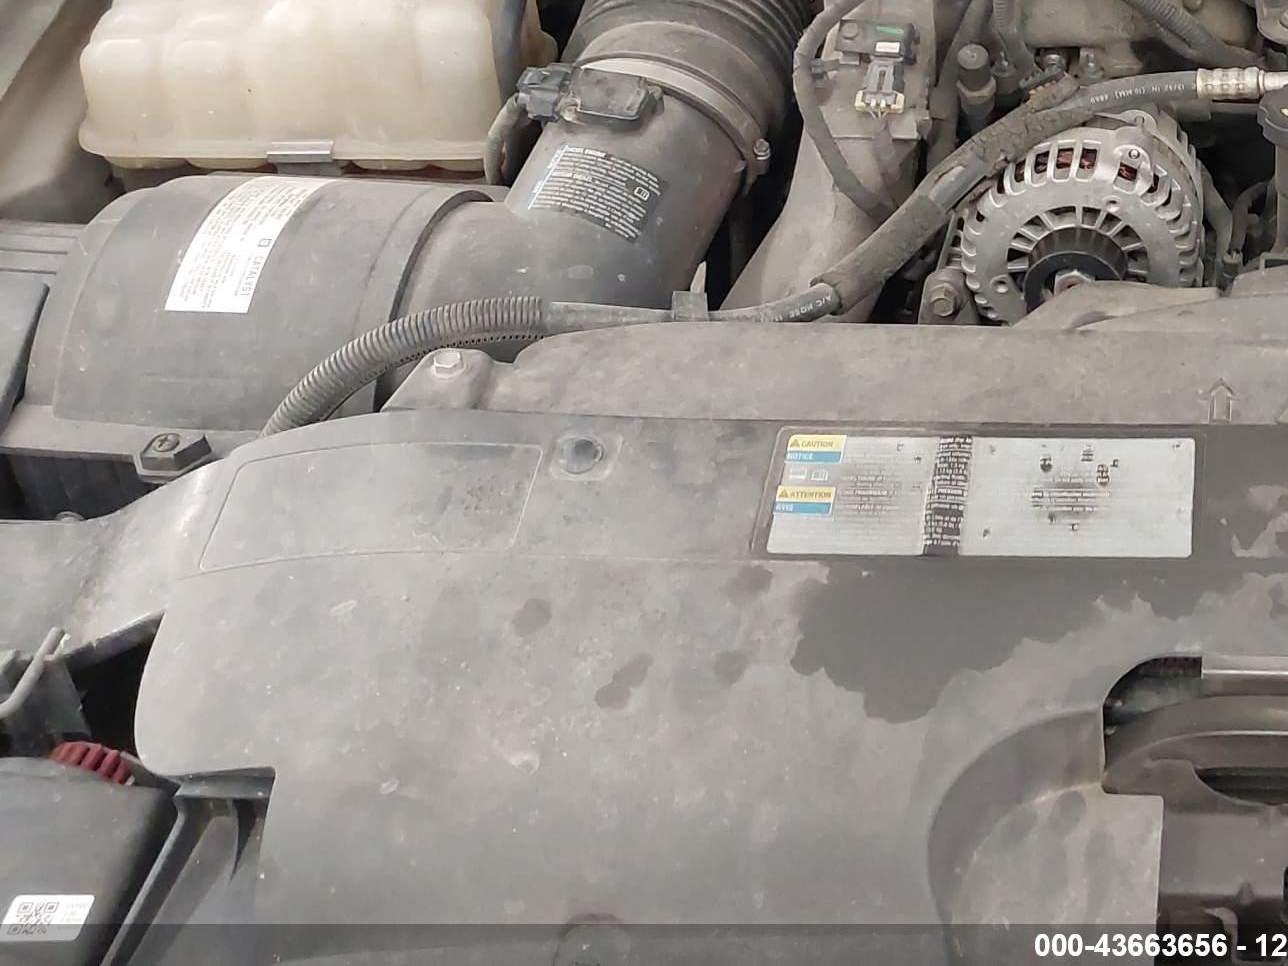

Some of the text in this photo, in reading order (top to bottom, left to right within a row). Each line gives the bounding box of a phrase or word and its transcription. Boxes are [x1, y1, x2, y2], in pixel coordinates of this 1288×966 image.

[800, 439, 834, 448] CAUTION
[785, 452, 815, 461] NOTICE
[789, 490, 833, 499] ATTENTION
